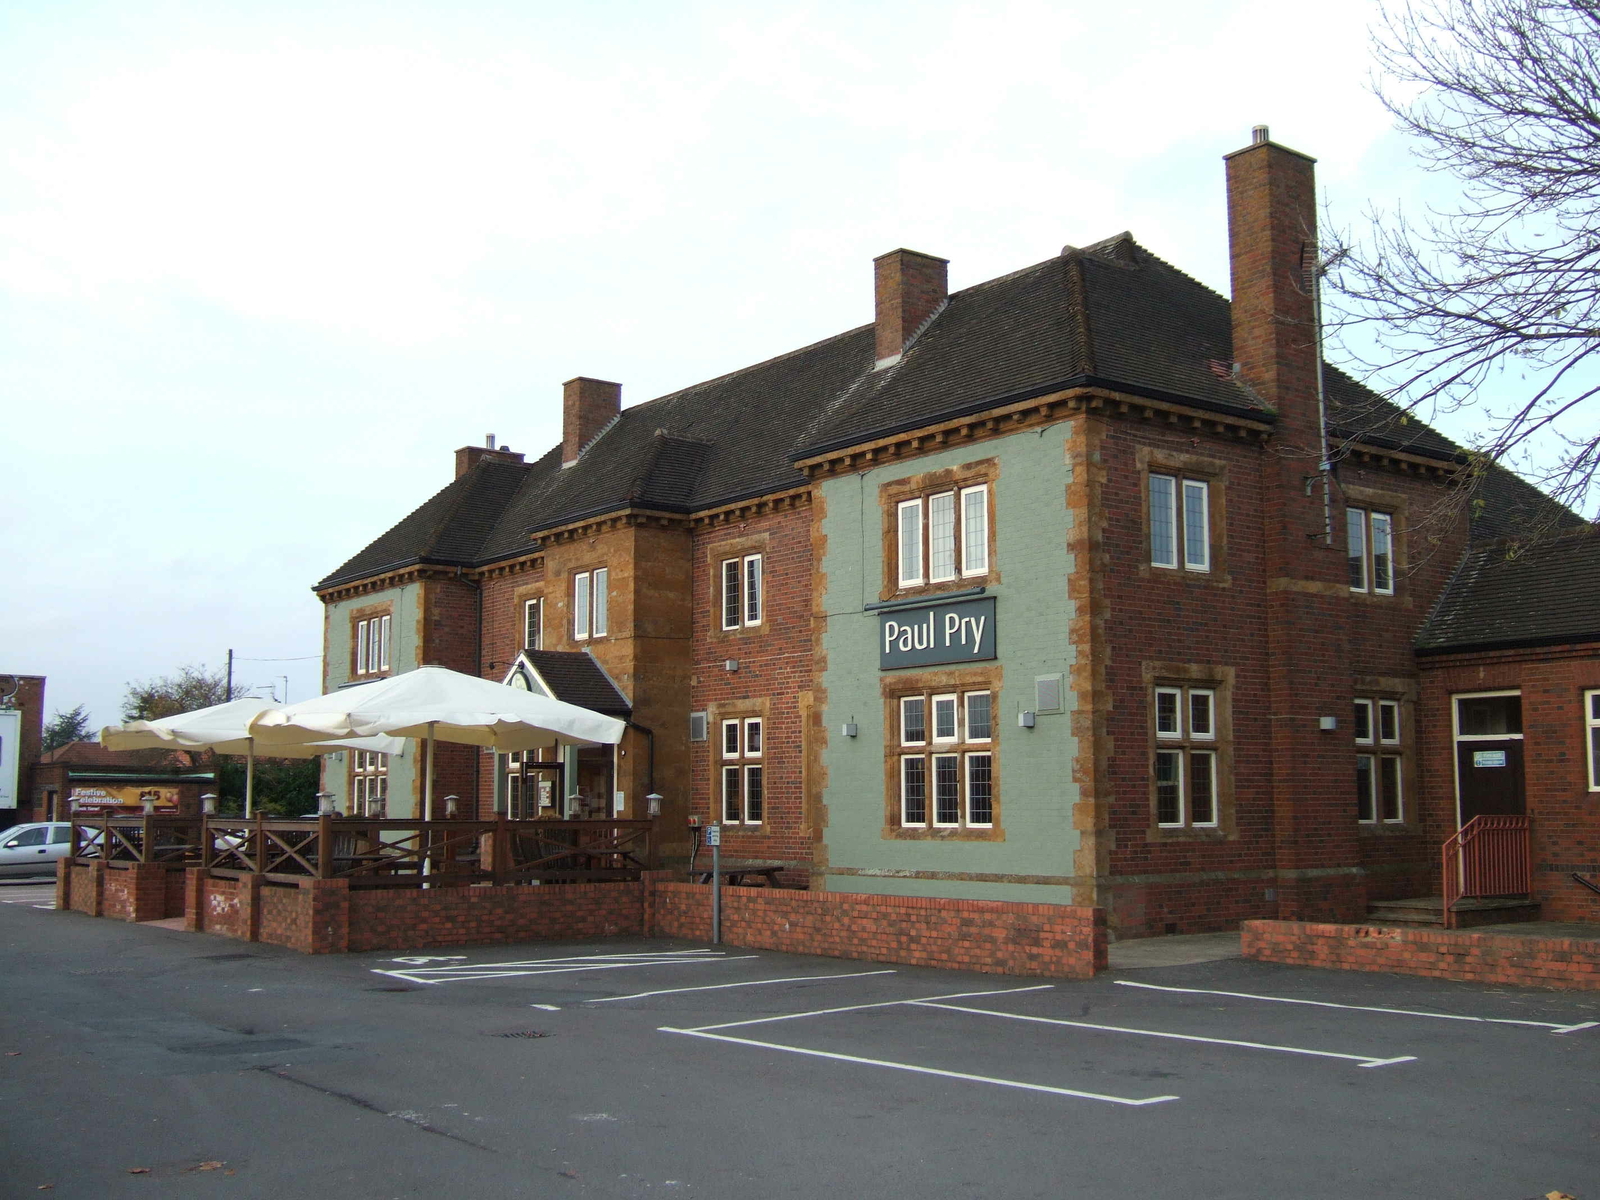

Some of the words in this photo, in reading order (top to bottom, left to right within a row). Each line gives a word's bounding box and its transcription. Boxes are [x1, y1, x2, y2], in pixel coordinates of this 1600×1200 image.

[885, 611, 935, 653] Paul
[945, 612, 985, 653] Pry
[75, 788, 106, 796] Festive
